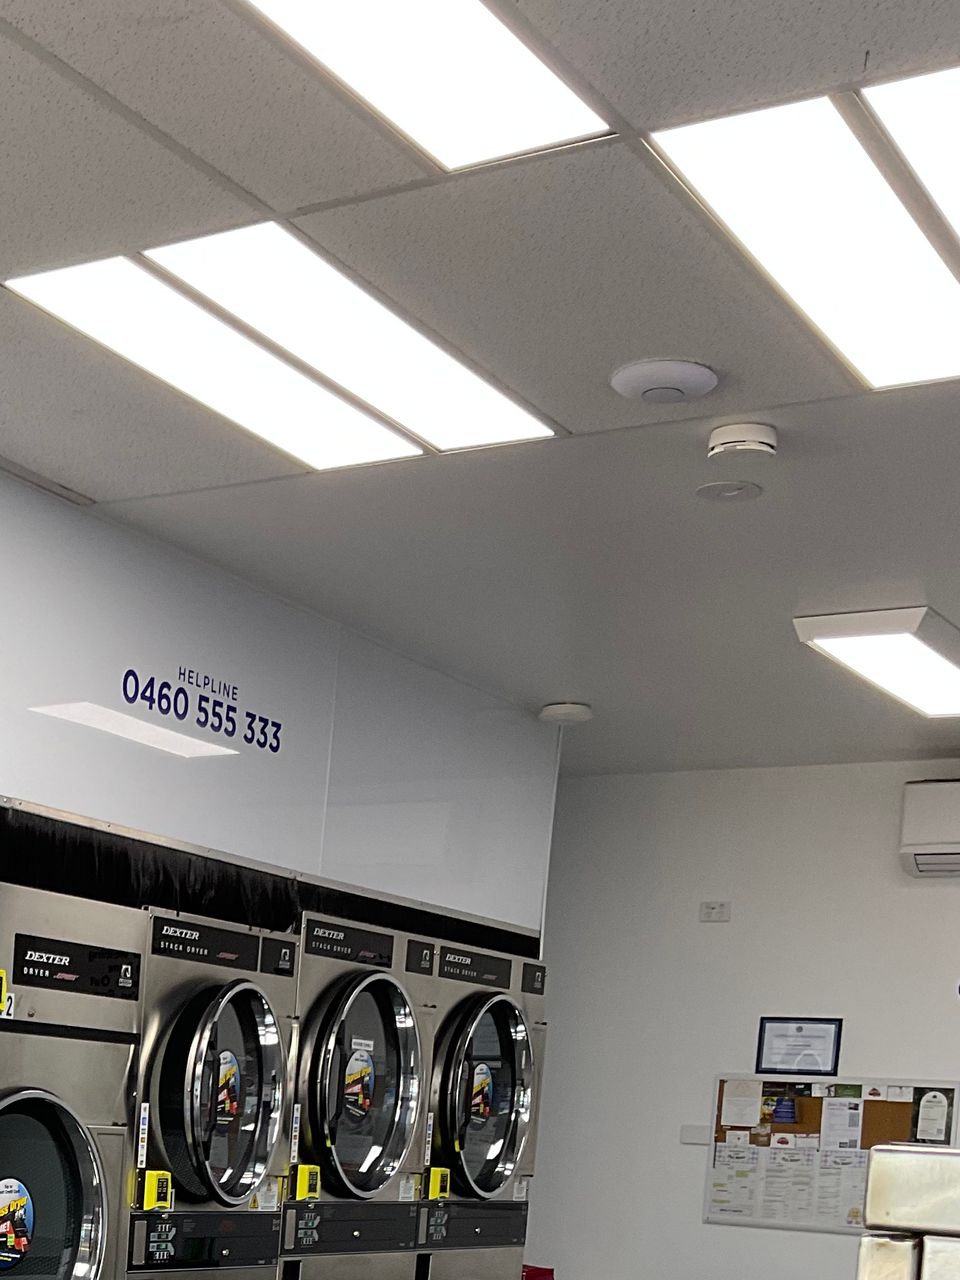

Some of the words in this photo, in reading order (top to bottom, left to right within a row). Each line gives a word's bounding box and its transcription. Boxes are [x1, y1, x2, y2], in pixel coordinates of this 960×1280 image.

[178, 666, 239, 701] HELPLINE
[122, 669, 189, 721] 0460
[196, 694, 237, 737] 555
[243, 711, 282, 753] 333
[162, 925, 200, 940] DEXTER
[313, 927, 345, 940] DEXTER
[160, 941, 183, 951] STACK
[187, 946, 208, 956] DRYER
[25, 950, 70, 966] DEXTER
[445, 953, 472, 965] DEXTER
[23, 966, 50, 977] DRYER
